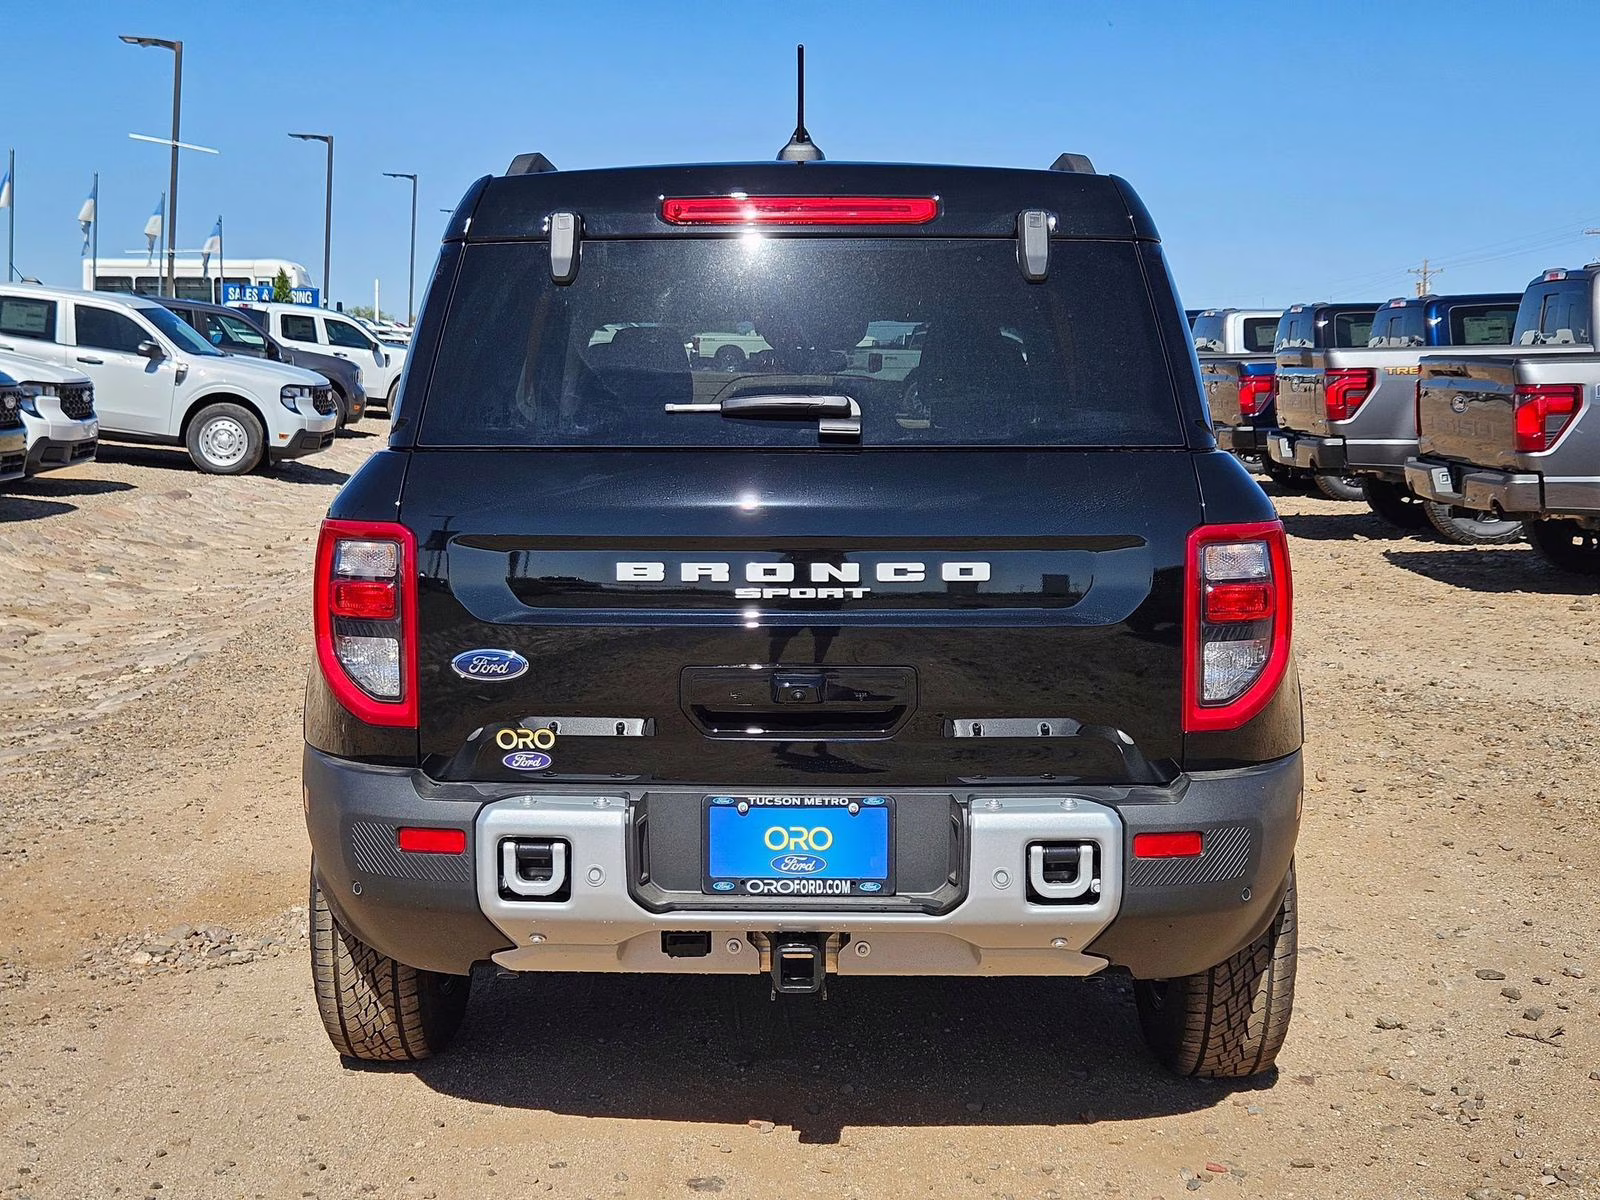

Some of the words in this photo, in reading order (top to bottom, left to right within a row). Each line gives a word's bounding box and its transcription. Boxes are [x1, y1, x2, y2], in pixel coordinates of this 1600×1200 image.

[228, 287, 259, 301] SALES
[1384, 366, 1419, 376] TRE
[615, 561, 992, 583] BRONCO
[734, 587, 871, 599] SPORT
[468, 655, 510, 674] Ford
[495, 728, 556, 750] ORO
[511, 753, 542, 767] Ford
[748, 797, 800, 806] TUCSON
[804, 797, 849, 806] METRO
[764, 826, 833, 851] ORO
[780, 856, 816, 872] Ford
[746, 879, 851, 894] OROFORD.COM
